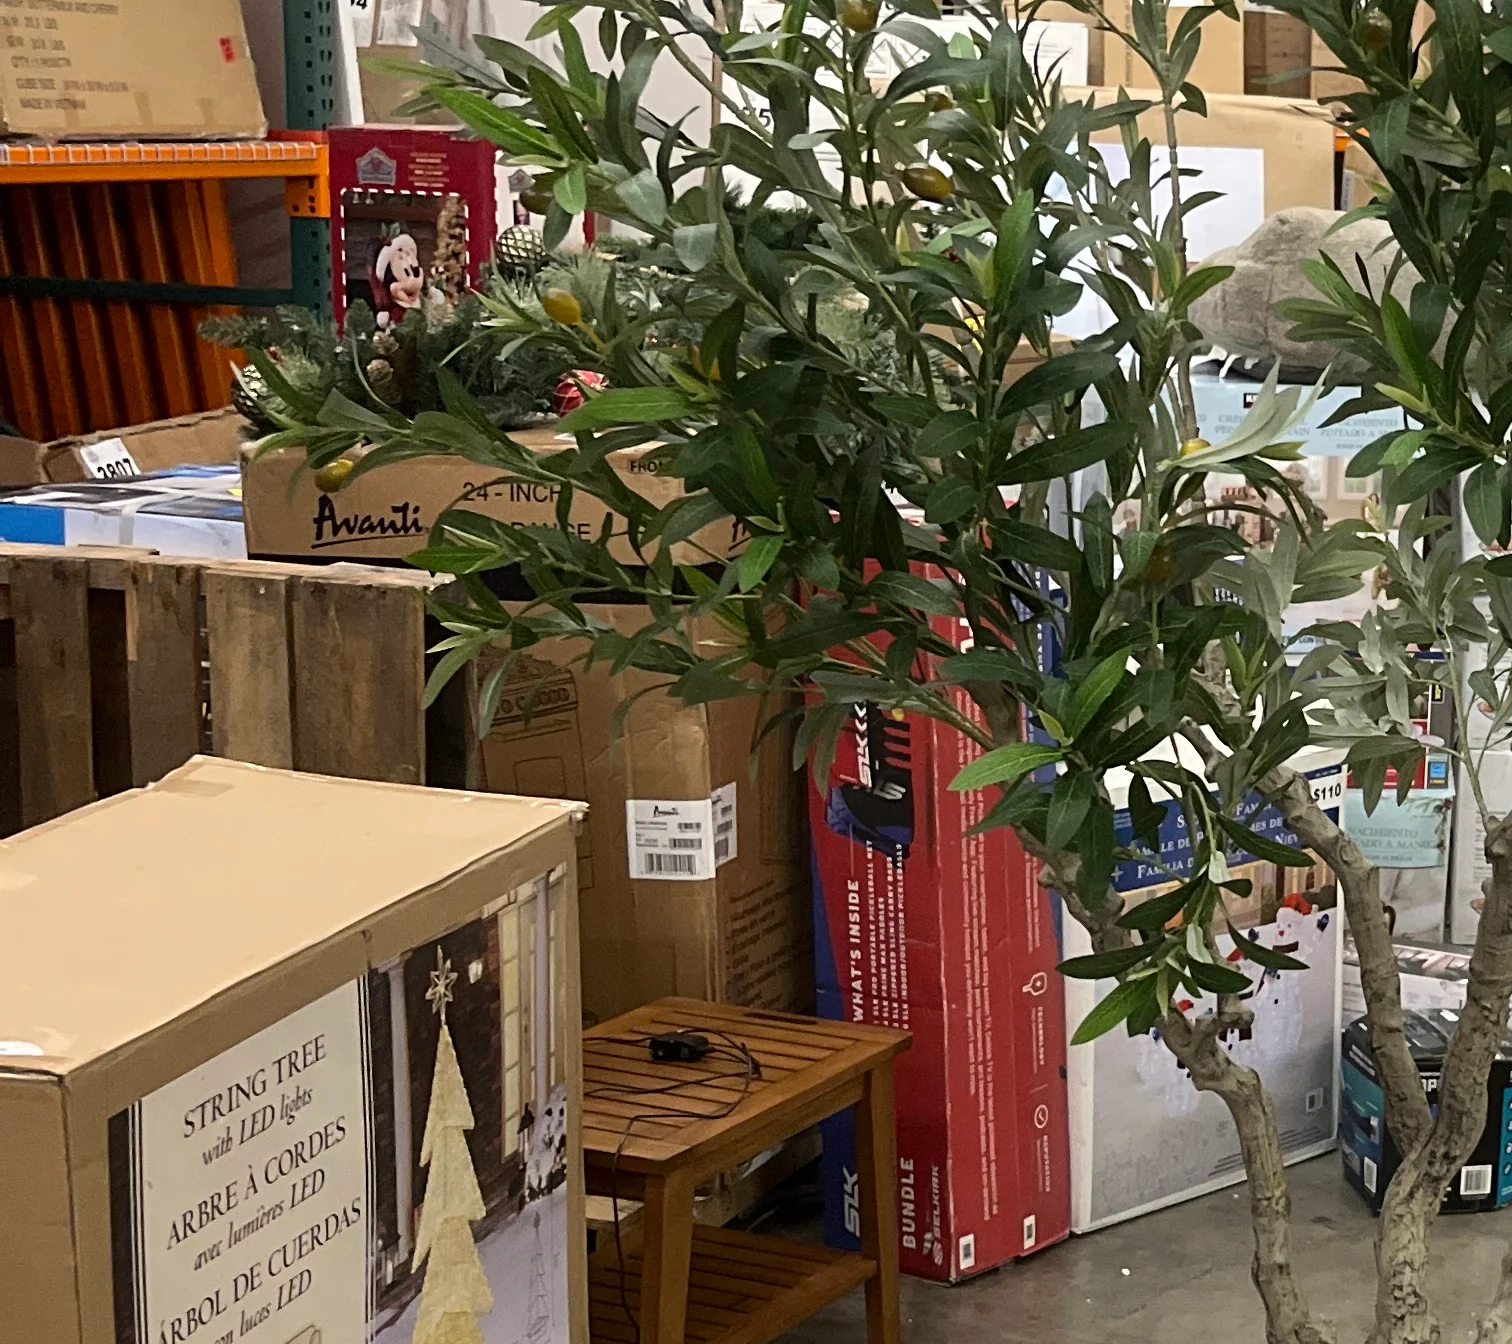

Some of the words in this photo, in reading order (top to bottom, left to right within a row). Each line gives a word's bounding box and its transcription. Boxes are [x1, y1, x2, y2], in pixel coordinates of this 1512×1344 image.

[463, 482, 488, 502] 24
[630, 460, 664, 472] FRO
[312, 492, 424, 541] Avanti
[847, 879, 862, 943] INSIDE
[849, 949, 865, 1022] WHAT'S
[183, 1068, 267, 1139] STRING
[272, 1033, 327, 1085] TREE
[202, 1125, 233, 1166] with
[238, 1104, 275, 1146] LED
[280, 1085, 313, 1126] lights
[165, 1180, 240, 1252] ARBRE
[264, 1115, 346, 1185] CORDES
[193, 1239, 223, 1271] avec
[289, 1168, 326, 1210] LED
[843, 1165, 861, 1238] SLK
[900, 1157, 917, 1249] BUNDLE
[233, 1262, 263, 1303] DE
[268, 1197, 361, 1277] CUERDAS
[240, 1302, 272, 1337] luces
[276, 1268, 313, 1312] LED
